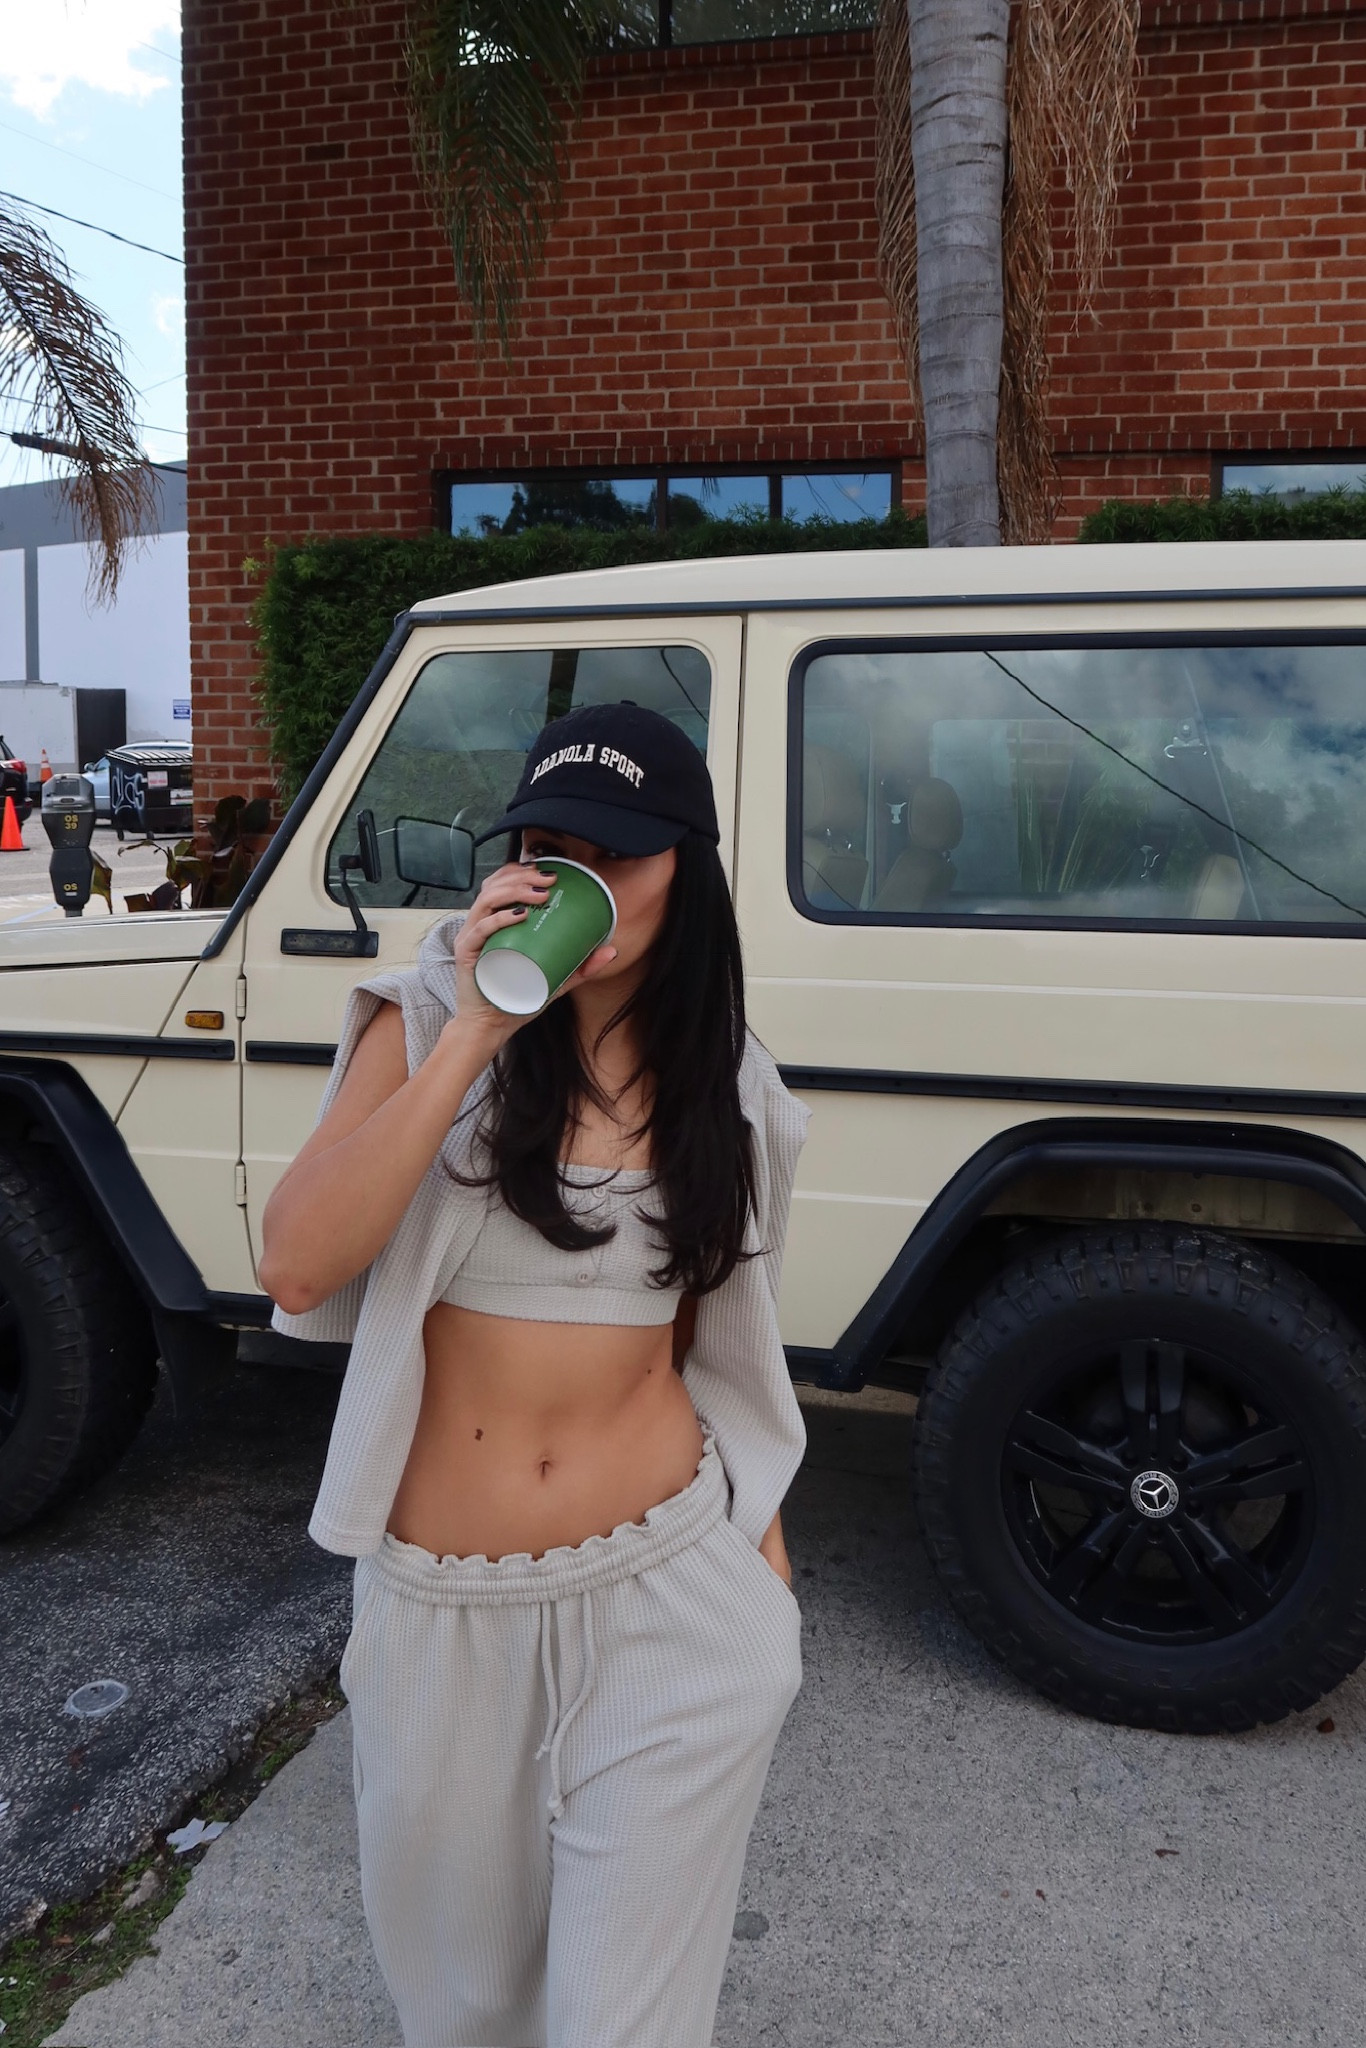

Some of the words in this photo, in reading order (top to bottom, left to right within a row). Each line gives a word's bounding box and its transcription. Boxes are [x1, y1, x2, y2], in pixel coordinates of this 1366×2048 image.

[530, 744, 596, 785] ADANOLA
[599, 747, 645, 789] SPORT
[64, 822, 78, 830] 39
